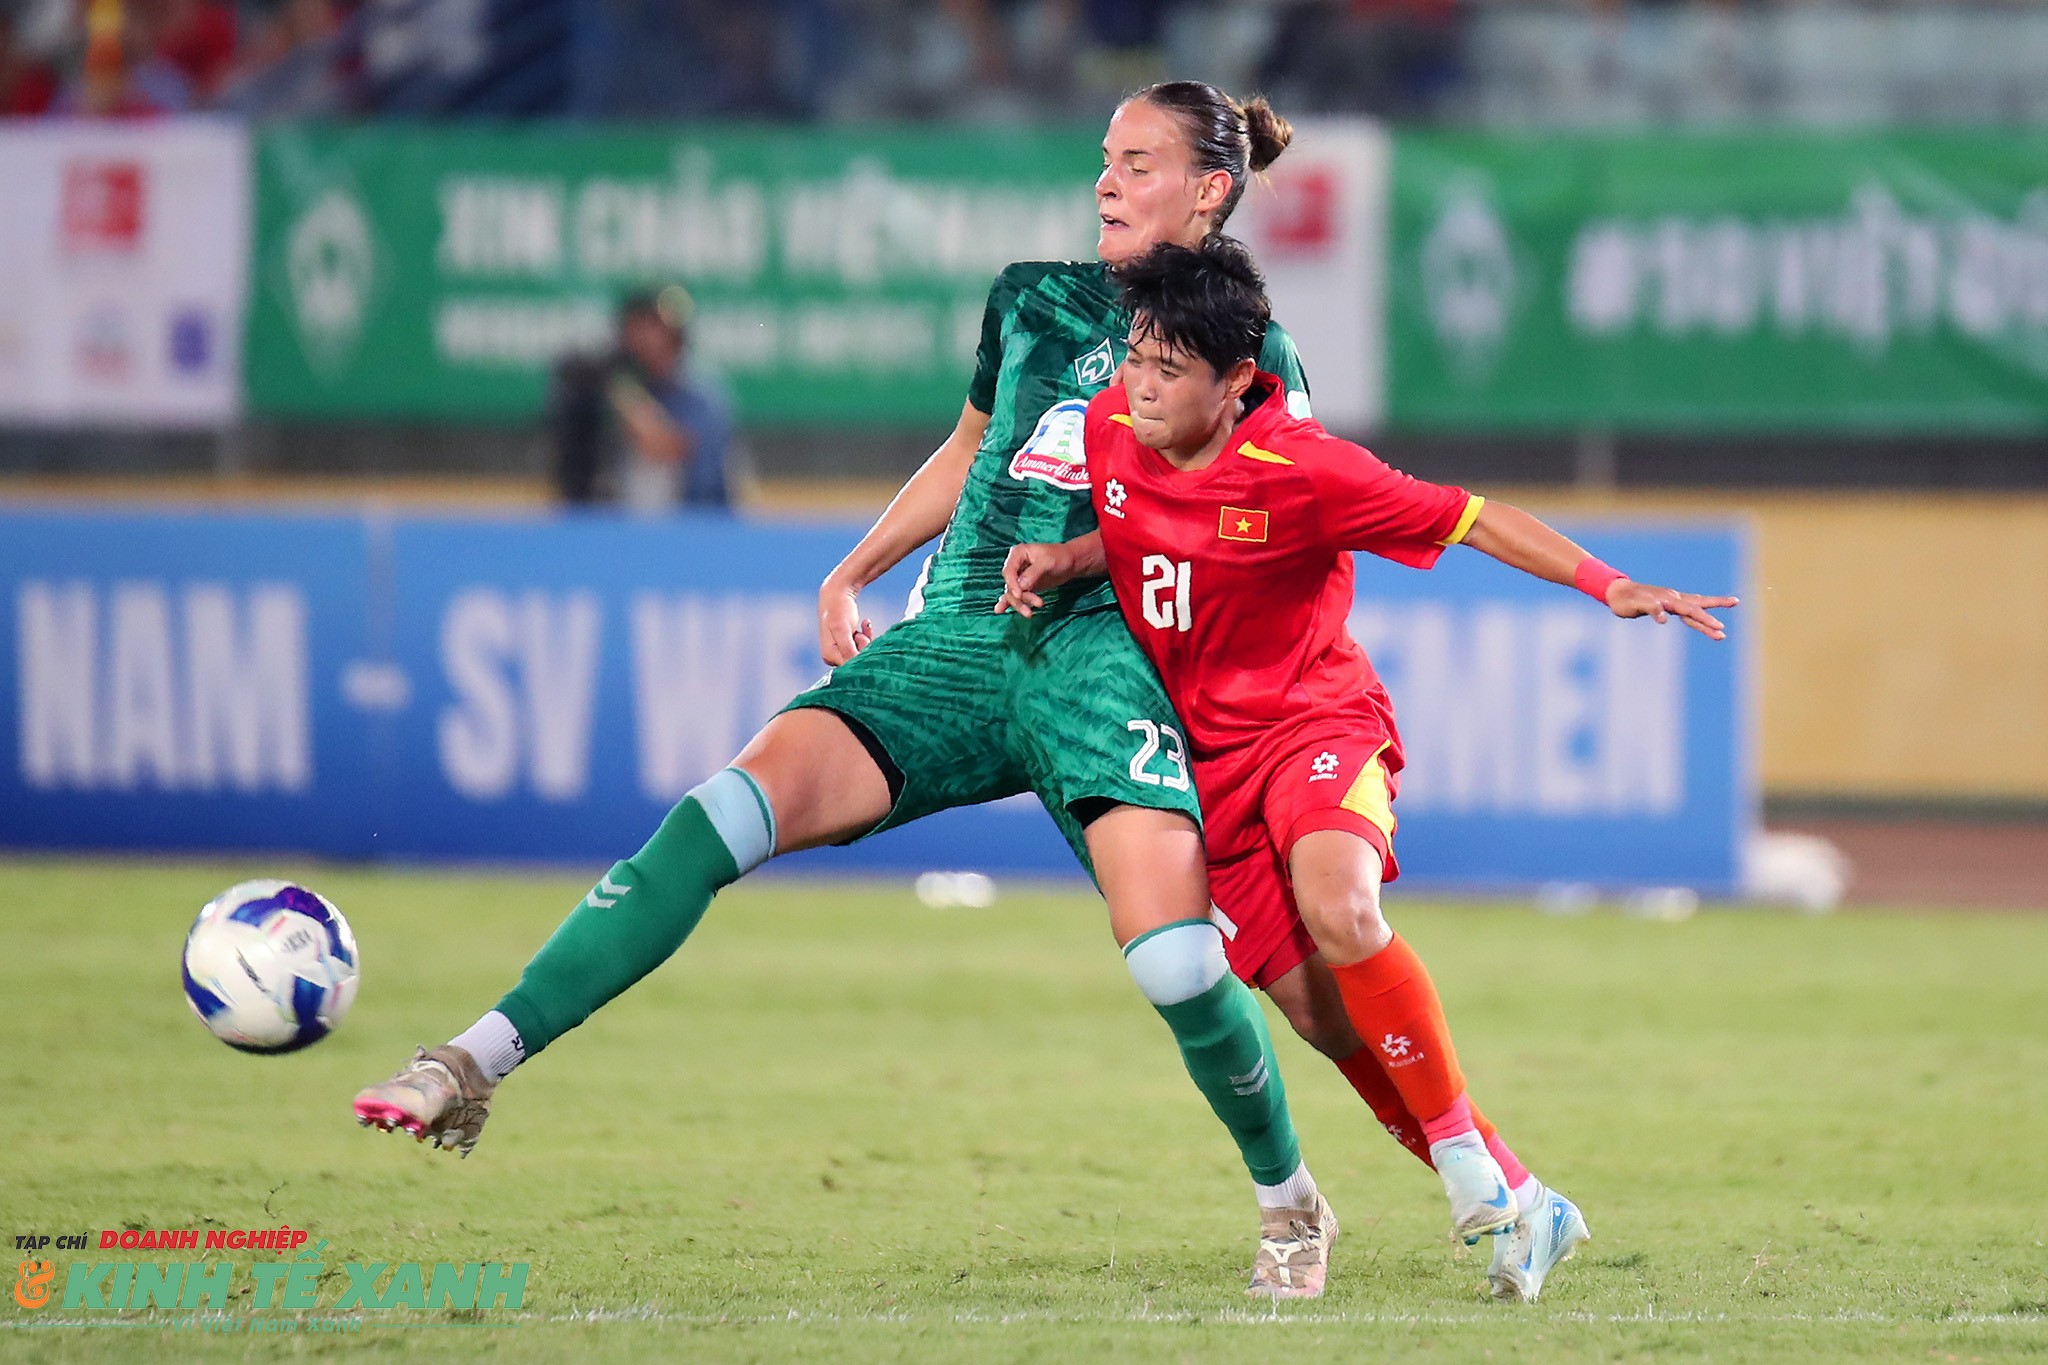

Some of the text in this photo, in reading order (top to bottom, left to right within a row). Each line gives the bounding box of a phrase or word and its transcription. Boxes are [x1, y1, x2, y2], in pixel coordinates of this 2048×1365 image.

[1015, 455, 1091, 481] Ammerlände
[1142, 554, 1192, 632] 21
[17, 582, 312, 792] NAM
[438, 588, 600, 800] SV
[1127, 719, 1190, 792] 23
